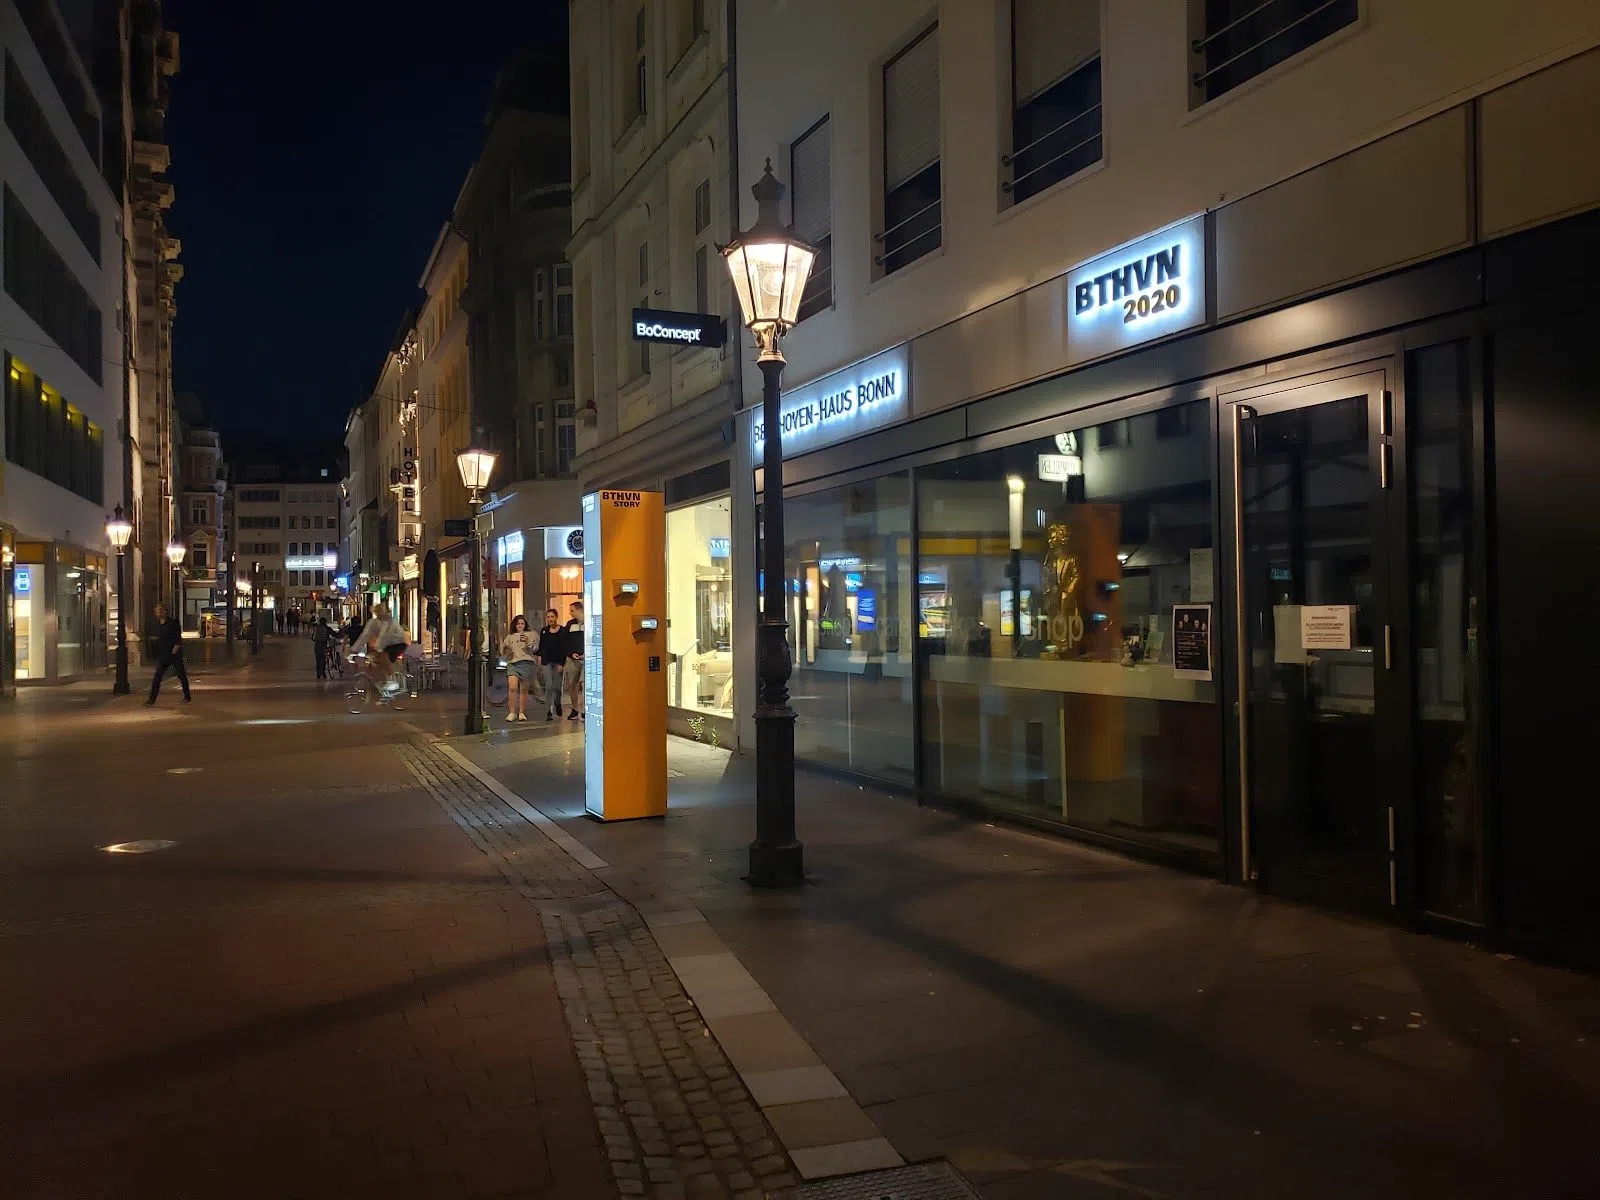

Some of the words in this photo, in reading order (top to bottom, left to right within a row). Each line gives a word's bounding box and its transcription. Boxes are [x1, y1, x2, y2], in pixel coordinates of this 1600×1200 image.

[1075, 244, 1181, 315] BTHVN
[1123, 284, 1181, 324] 2020
[857, 372, 896, 406] BONN
[403, 447, 414, 512] HOTEL
[602, 491, 641, 501] BTHVN
